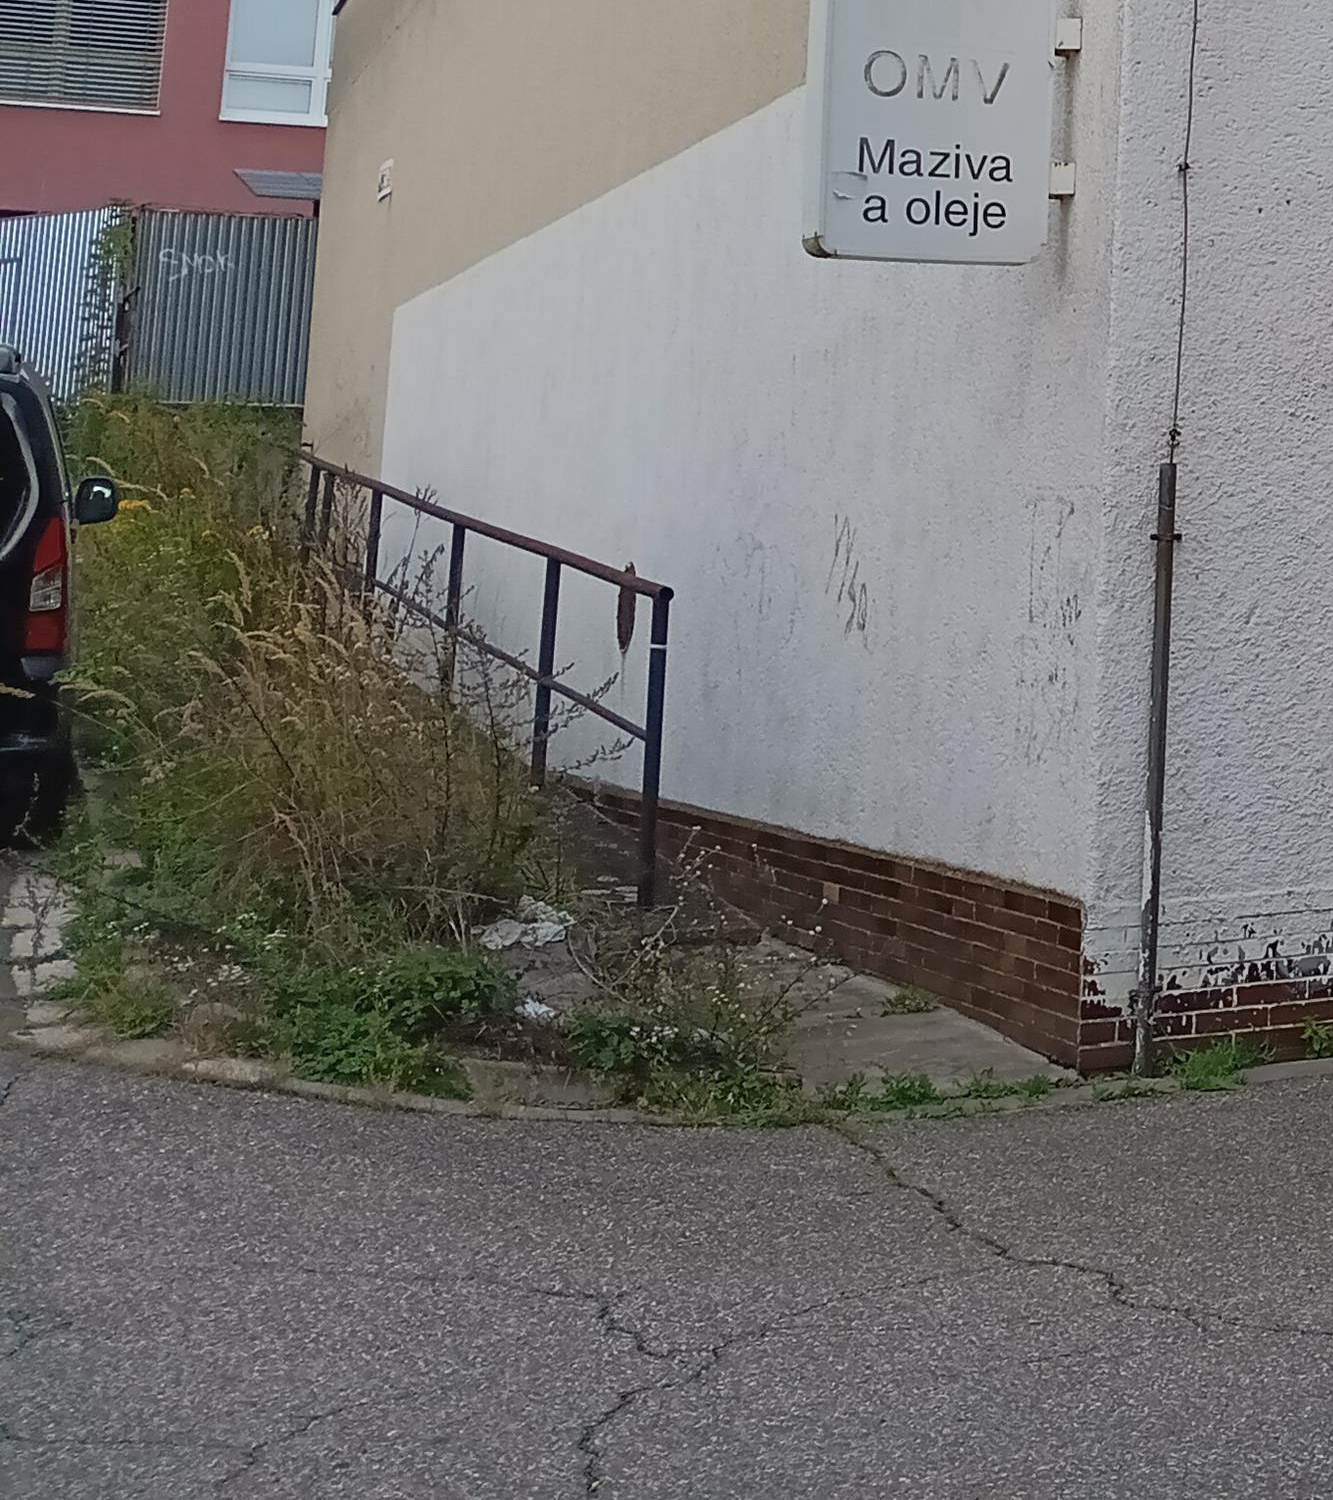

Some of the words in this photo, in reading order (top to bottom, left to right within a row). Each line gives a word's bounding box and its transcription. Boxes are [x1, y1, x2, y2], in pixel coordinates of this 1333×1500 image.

[864, 50, 1010, 105] OMV
[857, 136, 1013, 183] Maziva
[863, 195, 888, 223] a
[905, 190, 1006, 236] oleje
